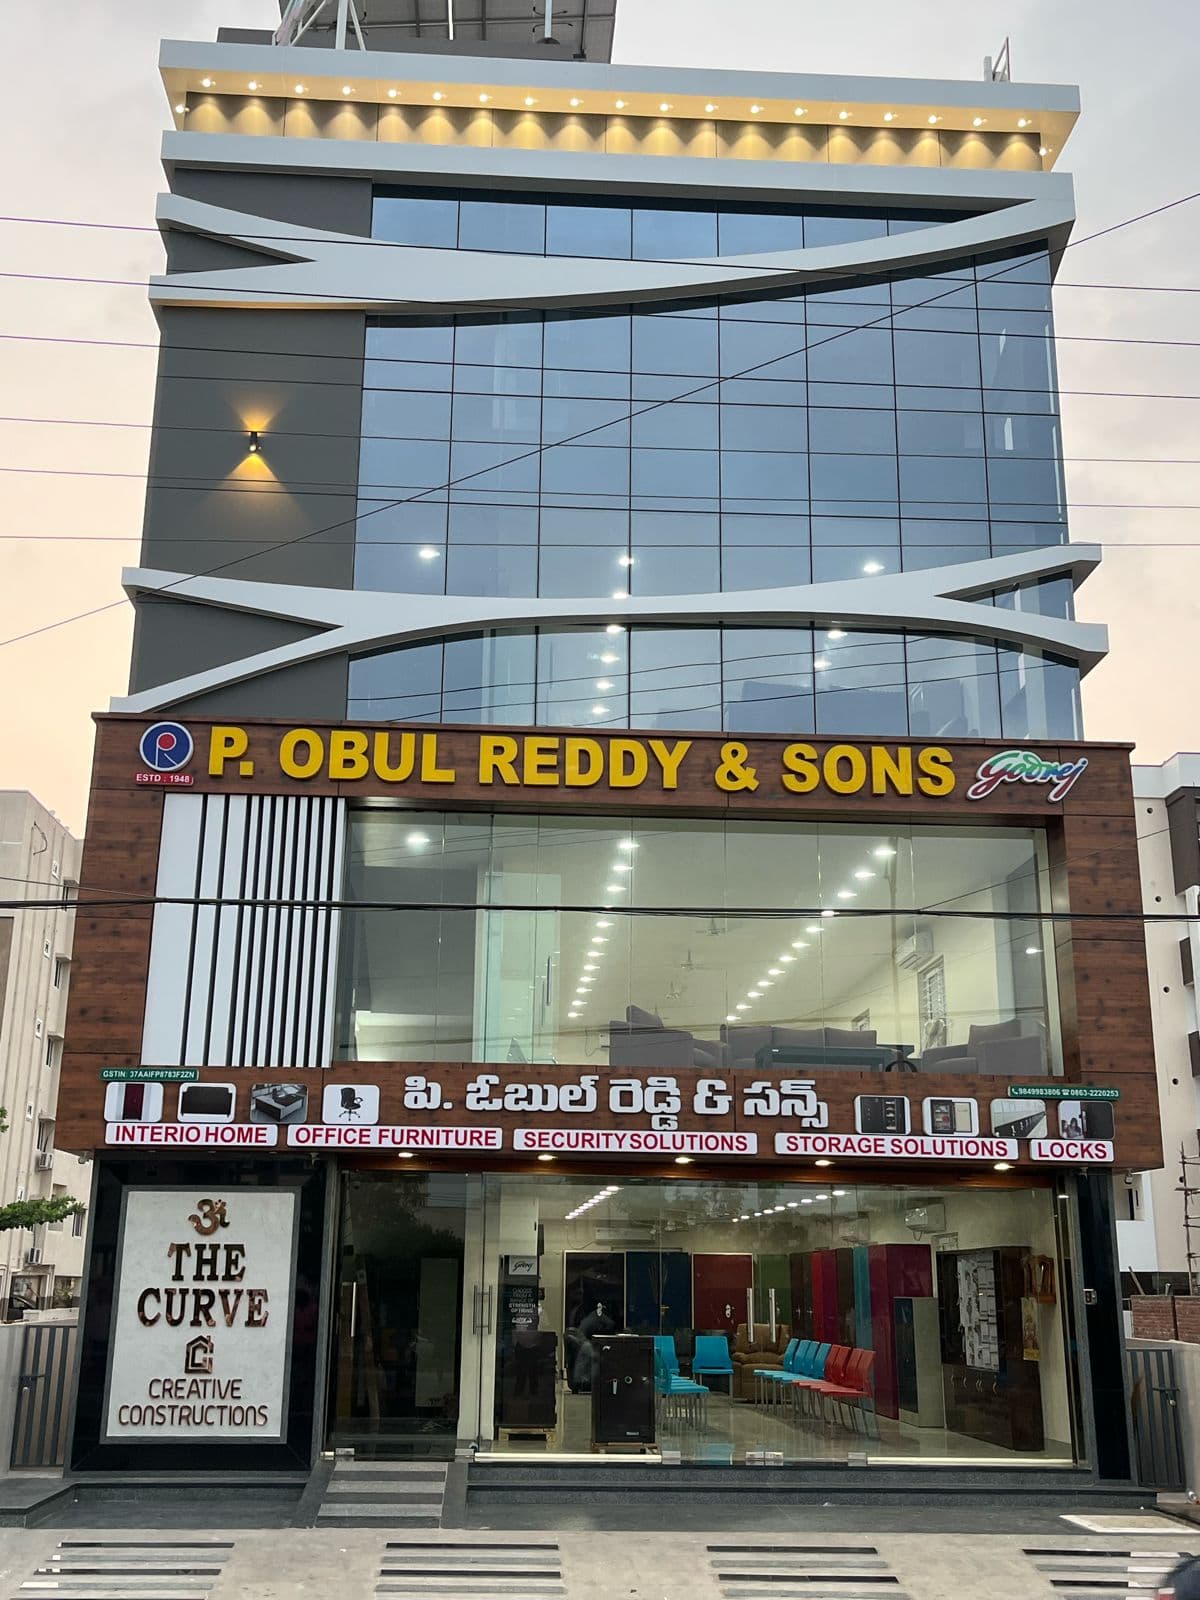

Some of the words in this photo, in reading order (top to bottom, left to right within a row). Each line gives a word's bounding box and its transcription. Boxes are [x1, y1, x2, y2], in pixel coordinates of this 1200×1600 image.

[208, 726, 254, 777] P.
[279, 728, 456, 784] OBUL
[479, 735, 692, 790] REDDY
[714, 741, 759, 792] &
[782, 743, 956, 796] SONS
[169, 774, 190, 783] 1948
[966, 750, 1088, 803] Godrej
[466, 1074, 600, 1112] ఓబుల్
[609, 1076, 681, 1131] రెడ్డి
[693, 1079, 733, 1115] &
[743, 1079, 829, 1129] సన్స్
[115, 1125, 201, 1143] INTERIO
[205, 1126, 267, 1144] HOME
[295, 1127, 371, 1145] OFFICE
[378, 1128, 497, 1147] FURNITURE
[523, 1131, 627, 1150] SECURITY
[629, 1132, 748, 1152] SOLUTIONS
[786, 1136, 885, 1155] STORAGE
[890, 1138, 1008, 1157] SOLUTIONS
[1037, 1142, 1107, 1160] LOCKS
[167, 1242, 246, 1282] THE
[137, 1287, 269, 1328] CURVE
[148, 1378, 243, 1400] CREATIVE
[118, 1404, 269, 1427] CONSTRUCTIONS
